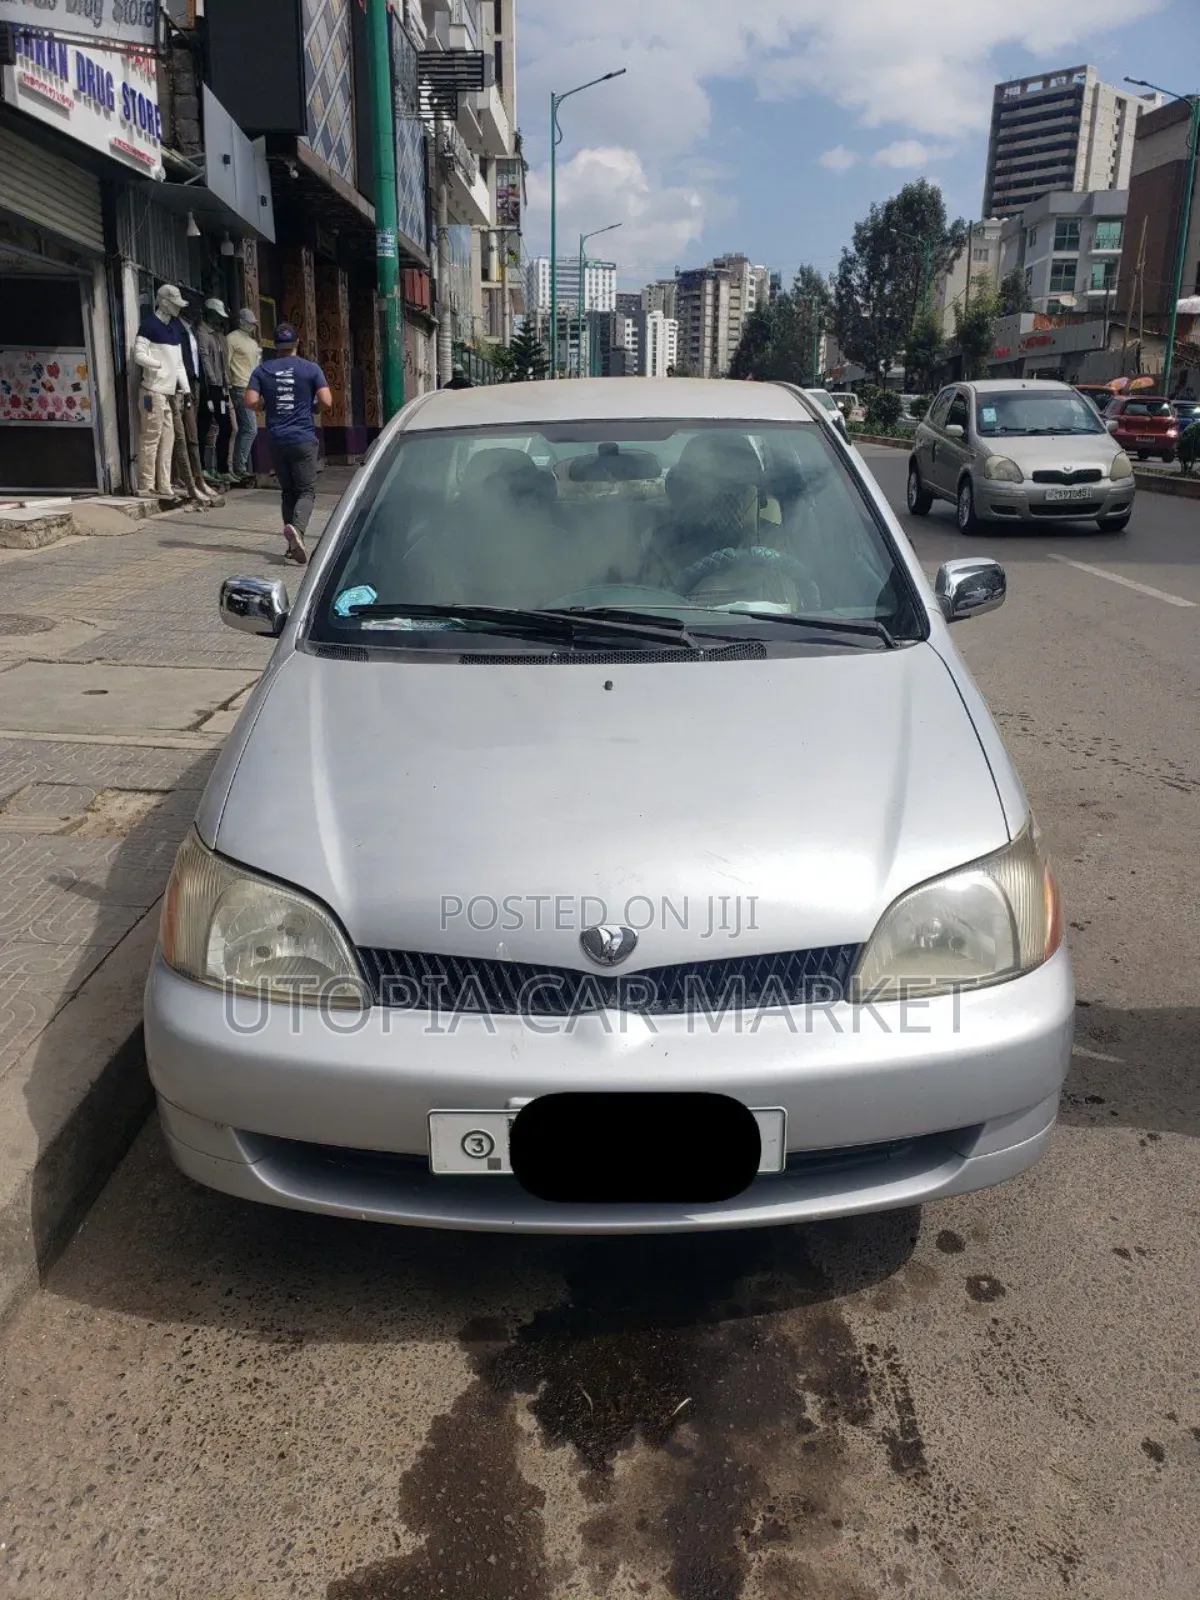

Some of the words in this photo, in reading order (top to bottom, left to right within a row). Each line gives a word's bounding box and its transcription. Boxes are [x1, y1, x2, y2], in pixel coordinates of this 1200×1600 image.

[76, 50, 115, 112] DRUG
[121, 81, 161, 140] STORE
[470, 1136, 486, 1154] 3
